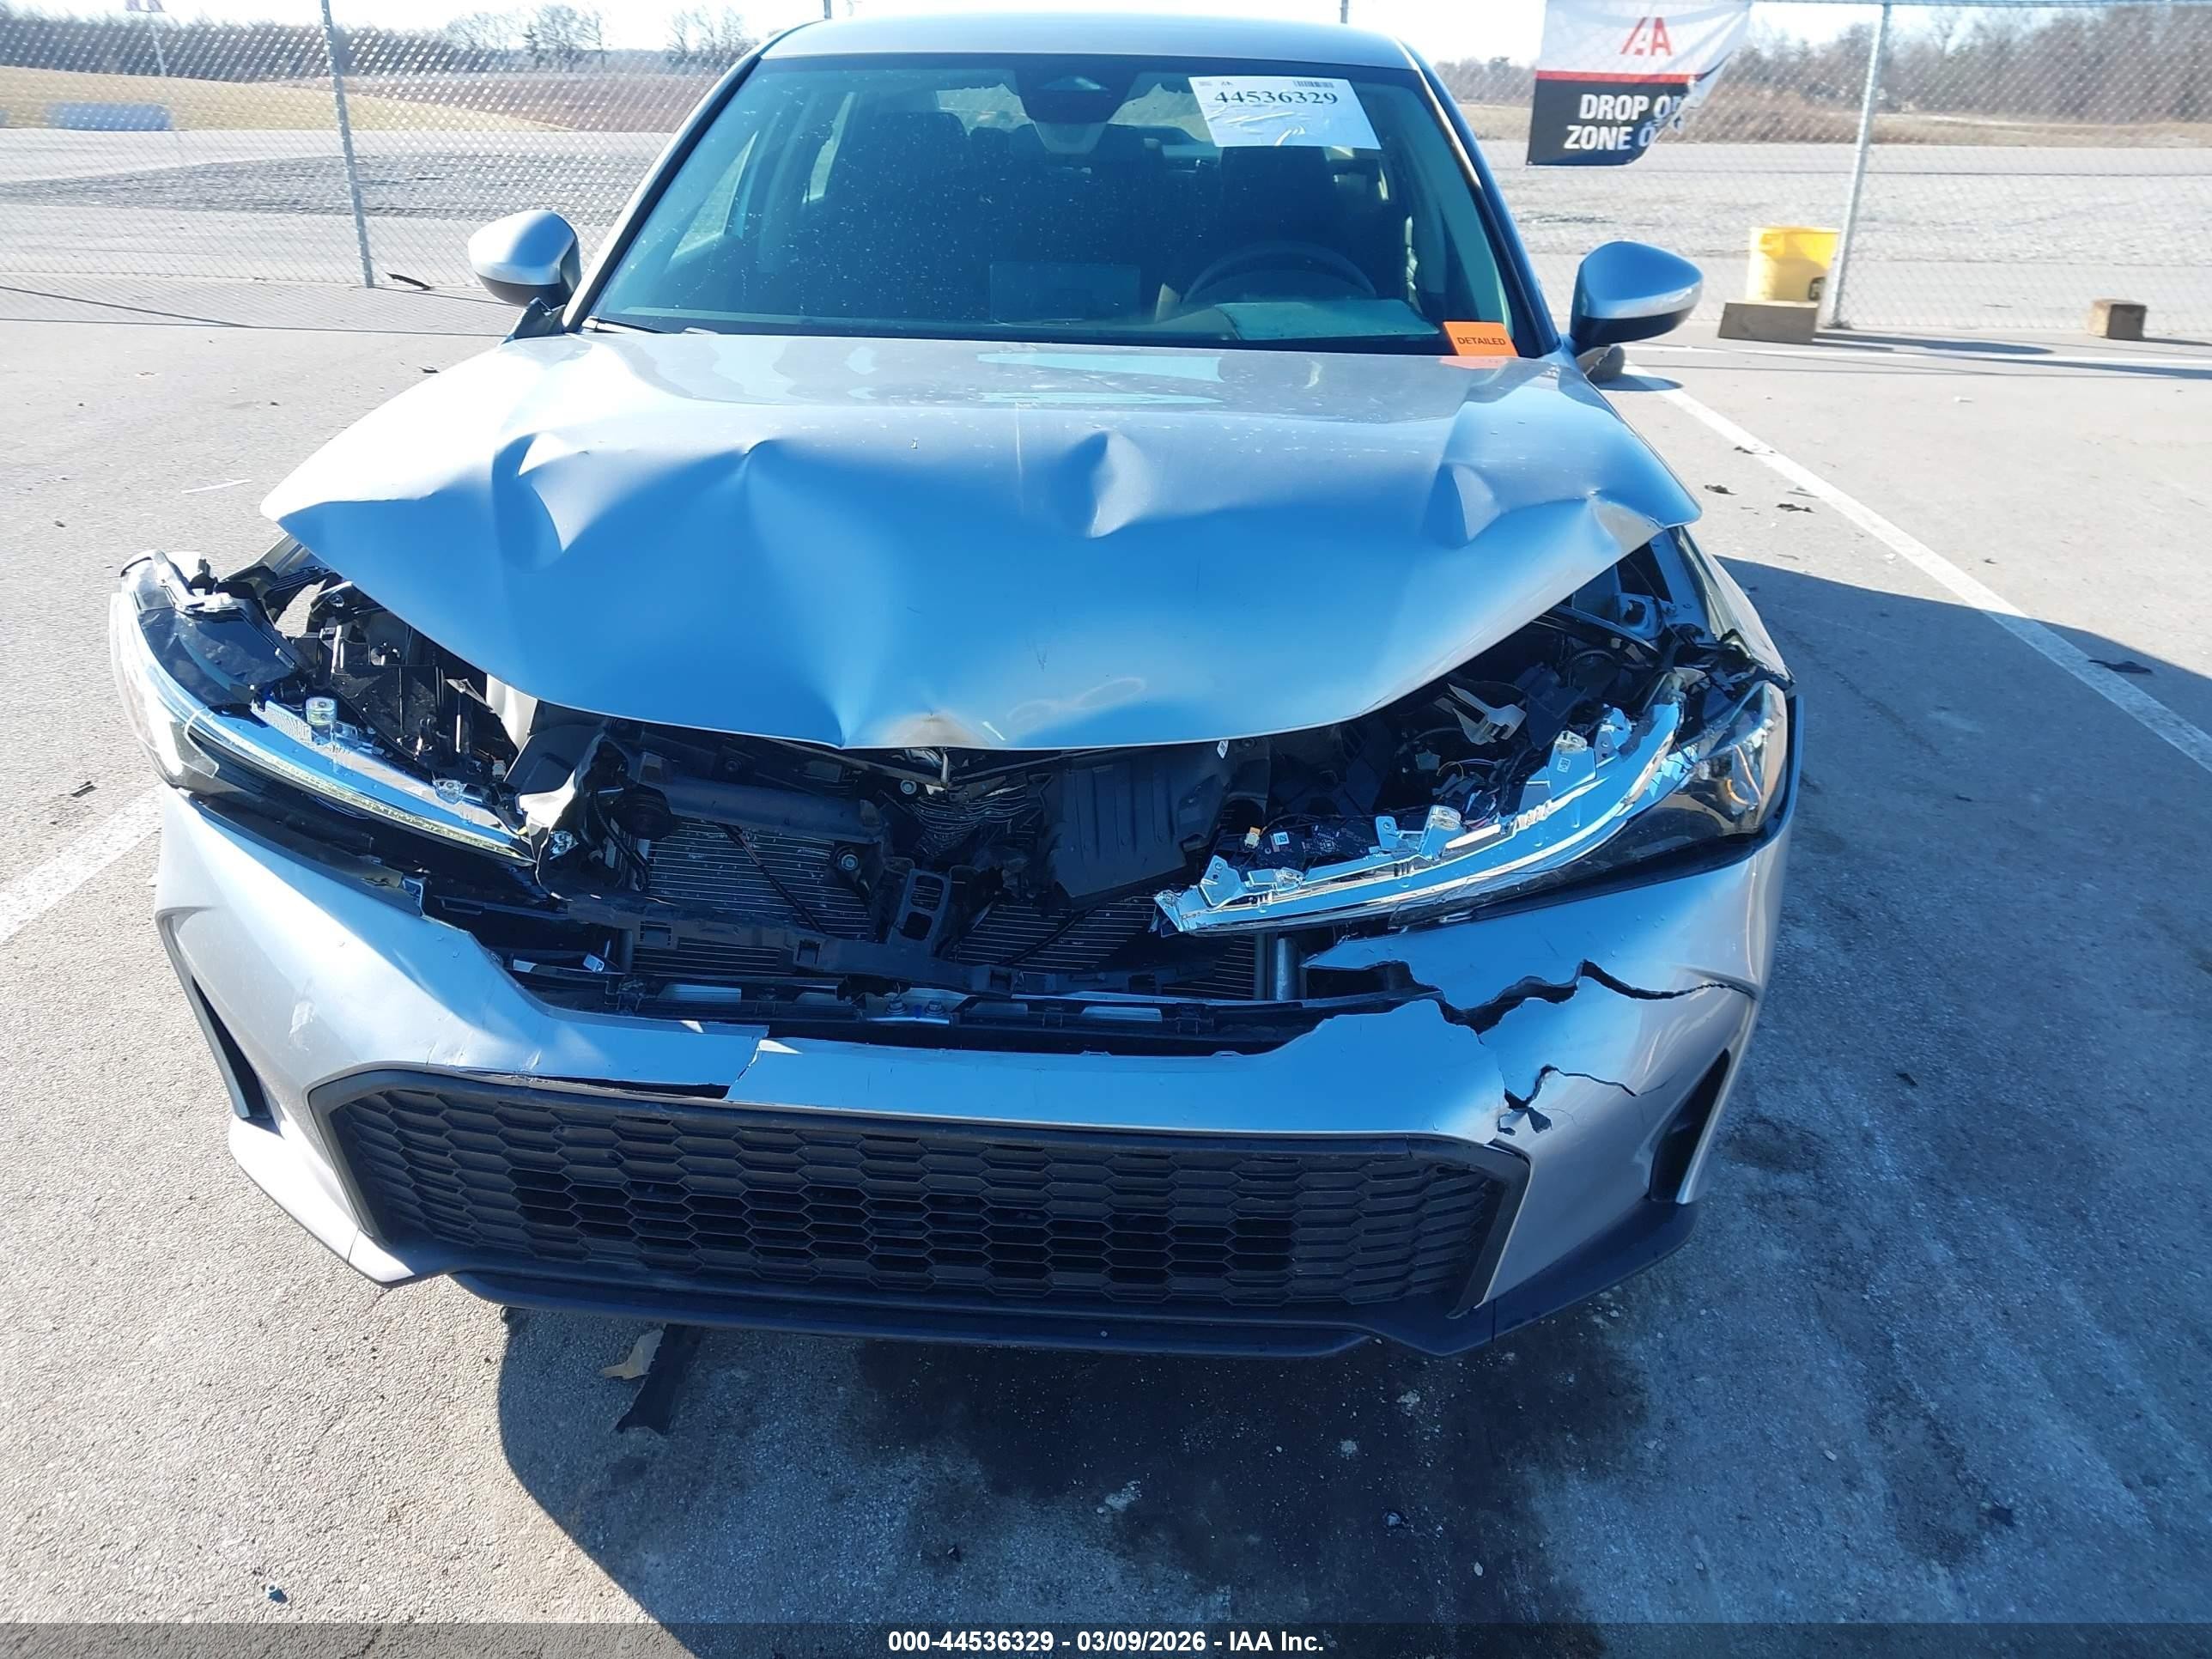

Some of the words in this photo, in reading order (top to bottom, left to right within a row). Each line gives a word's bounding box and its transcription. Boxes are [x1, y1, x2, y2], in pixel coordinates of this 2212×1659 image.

[1213, 90, 1339, 105] 44536329
[1578, 94, 1650, 121] DROP
[1563, 125, 1635, 150] ZONE
[1456, 337, 1506, 346] DETAILED
